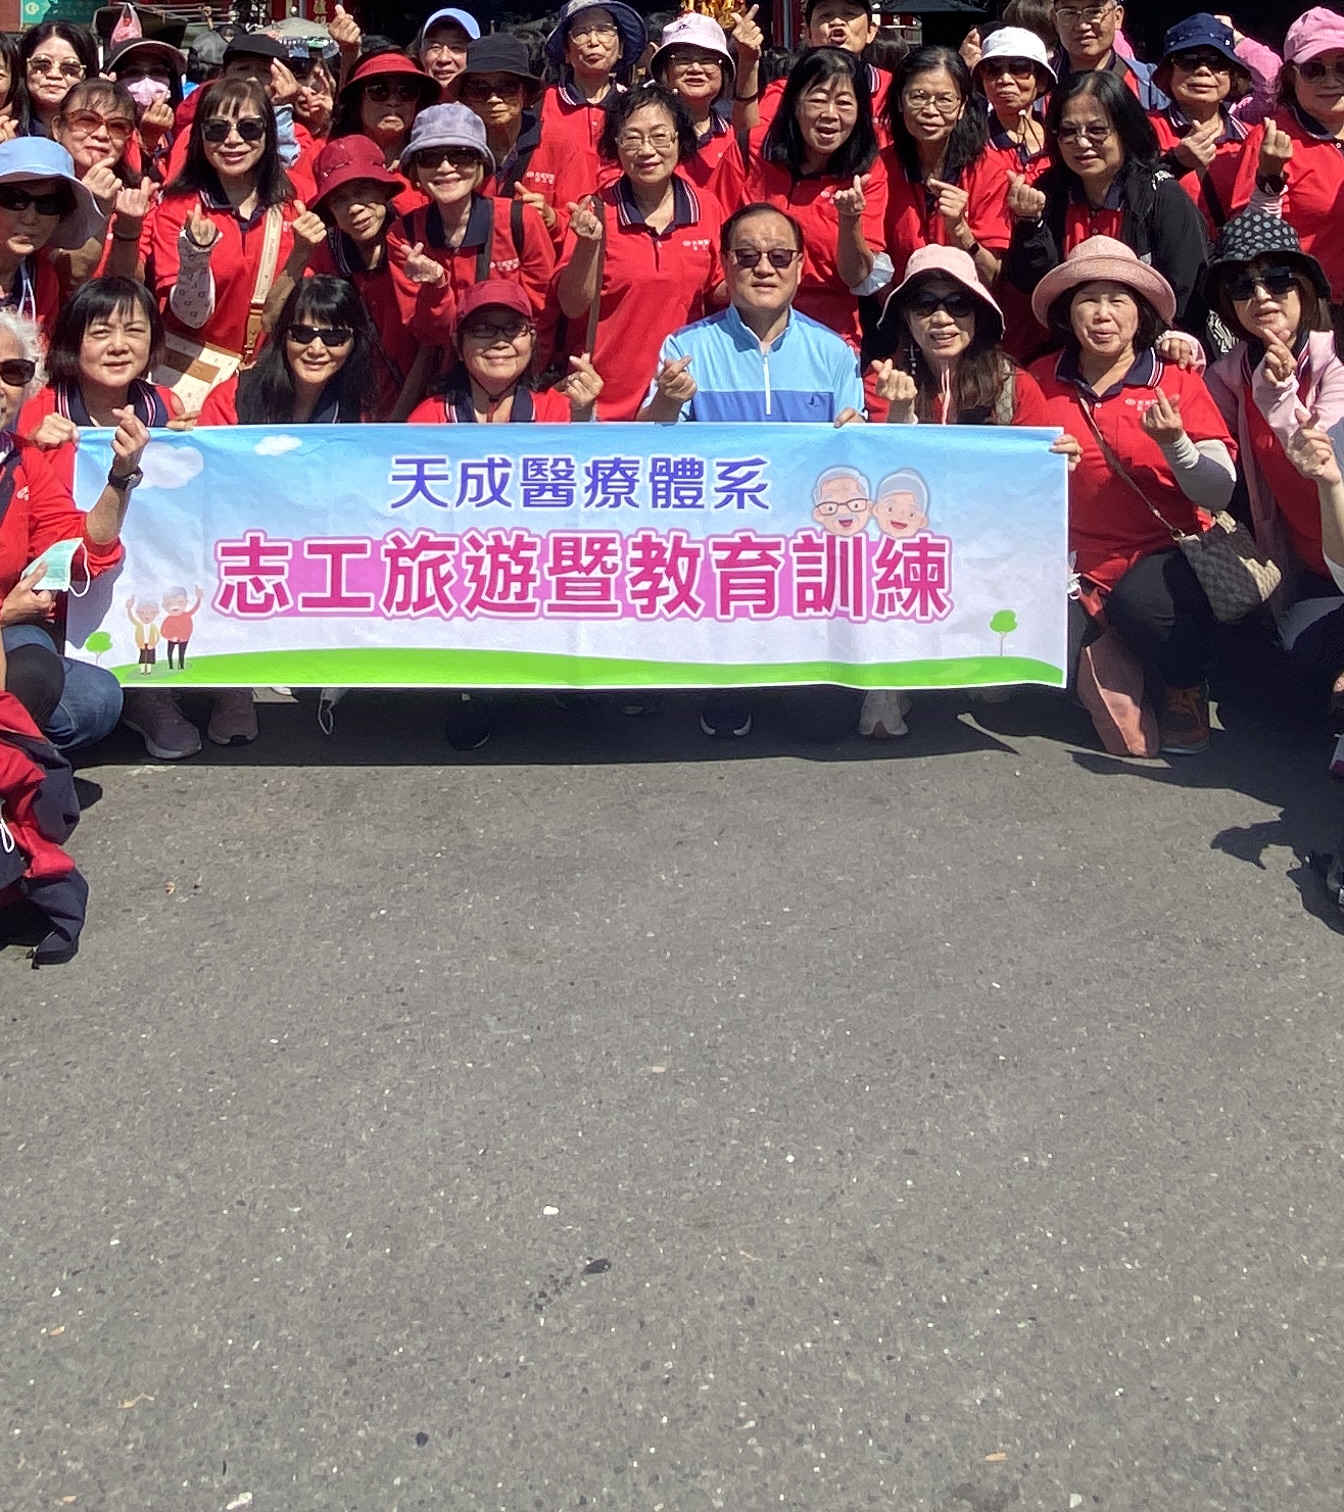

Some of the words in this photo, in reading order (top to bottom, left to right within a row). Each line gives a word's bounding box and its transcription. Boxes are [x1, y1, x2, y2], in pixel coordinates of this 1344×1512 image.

[389, 455, 771, 511] 天成醫療體系
[217, 530, 953, 623] 志工旅遊暨教育訓練
